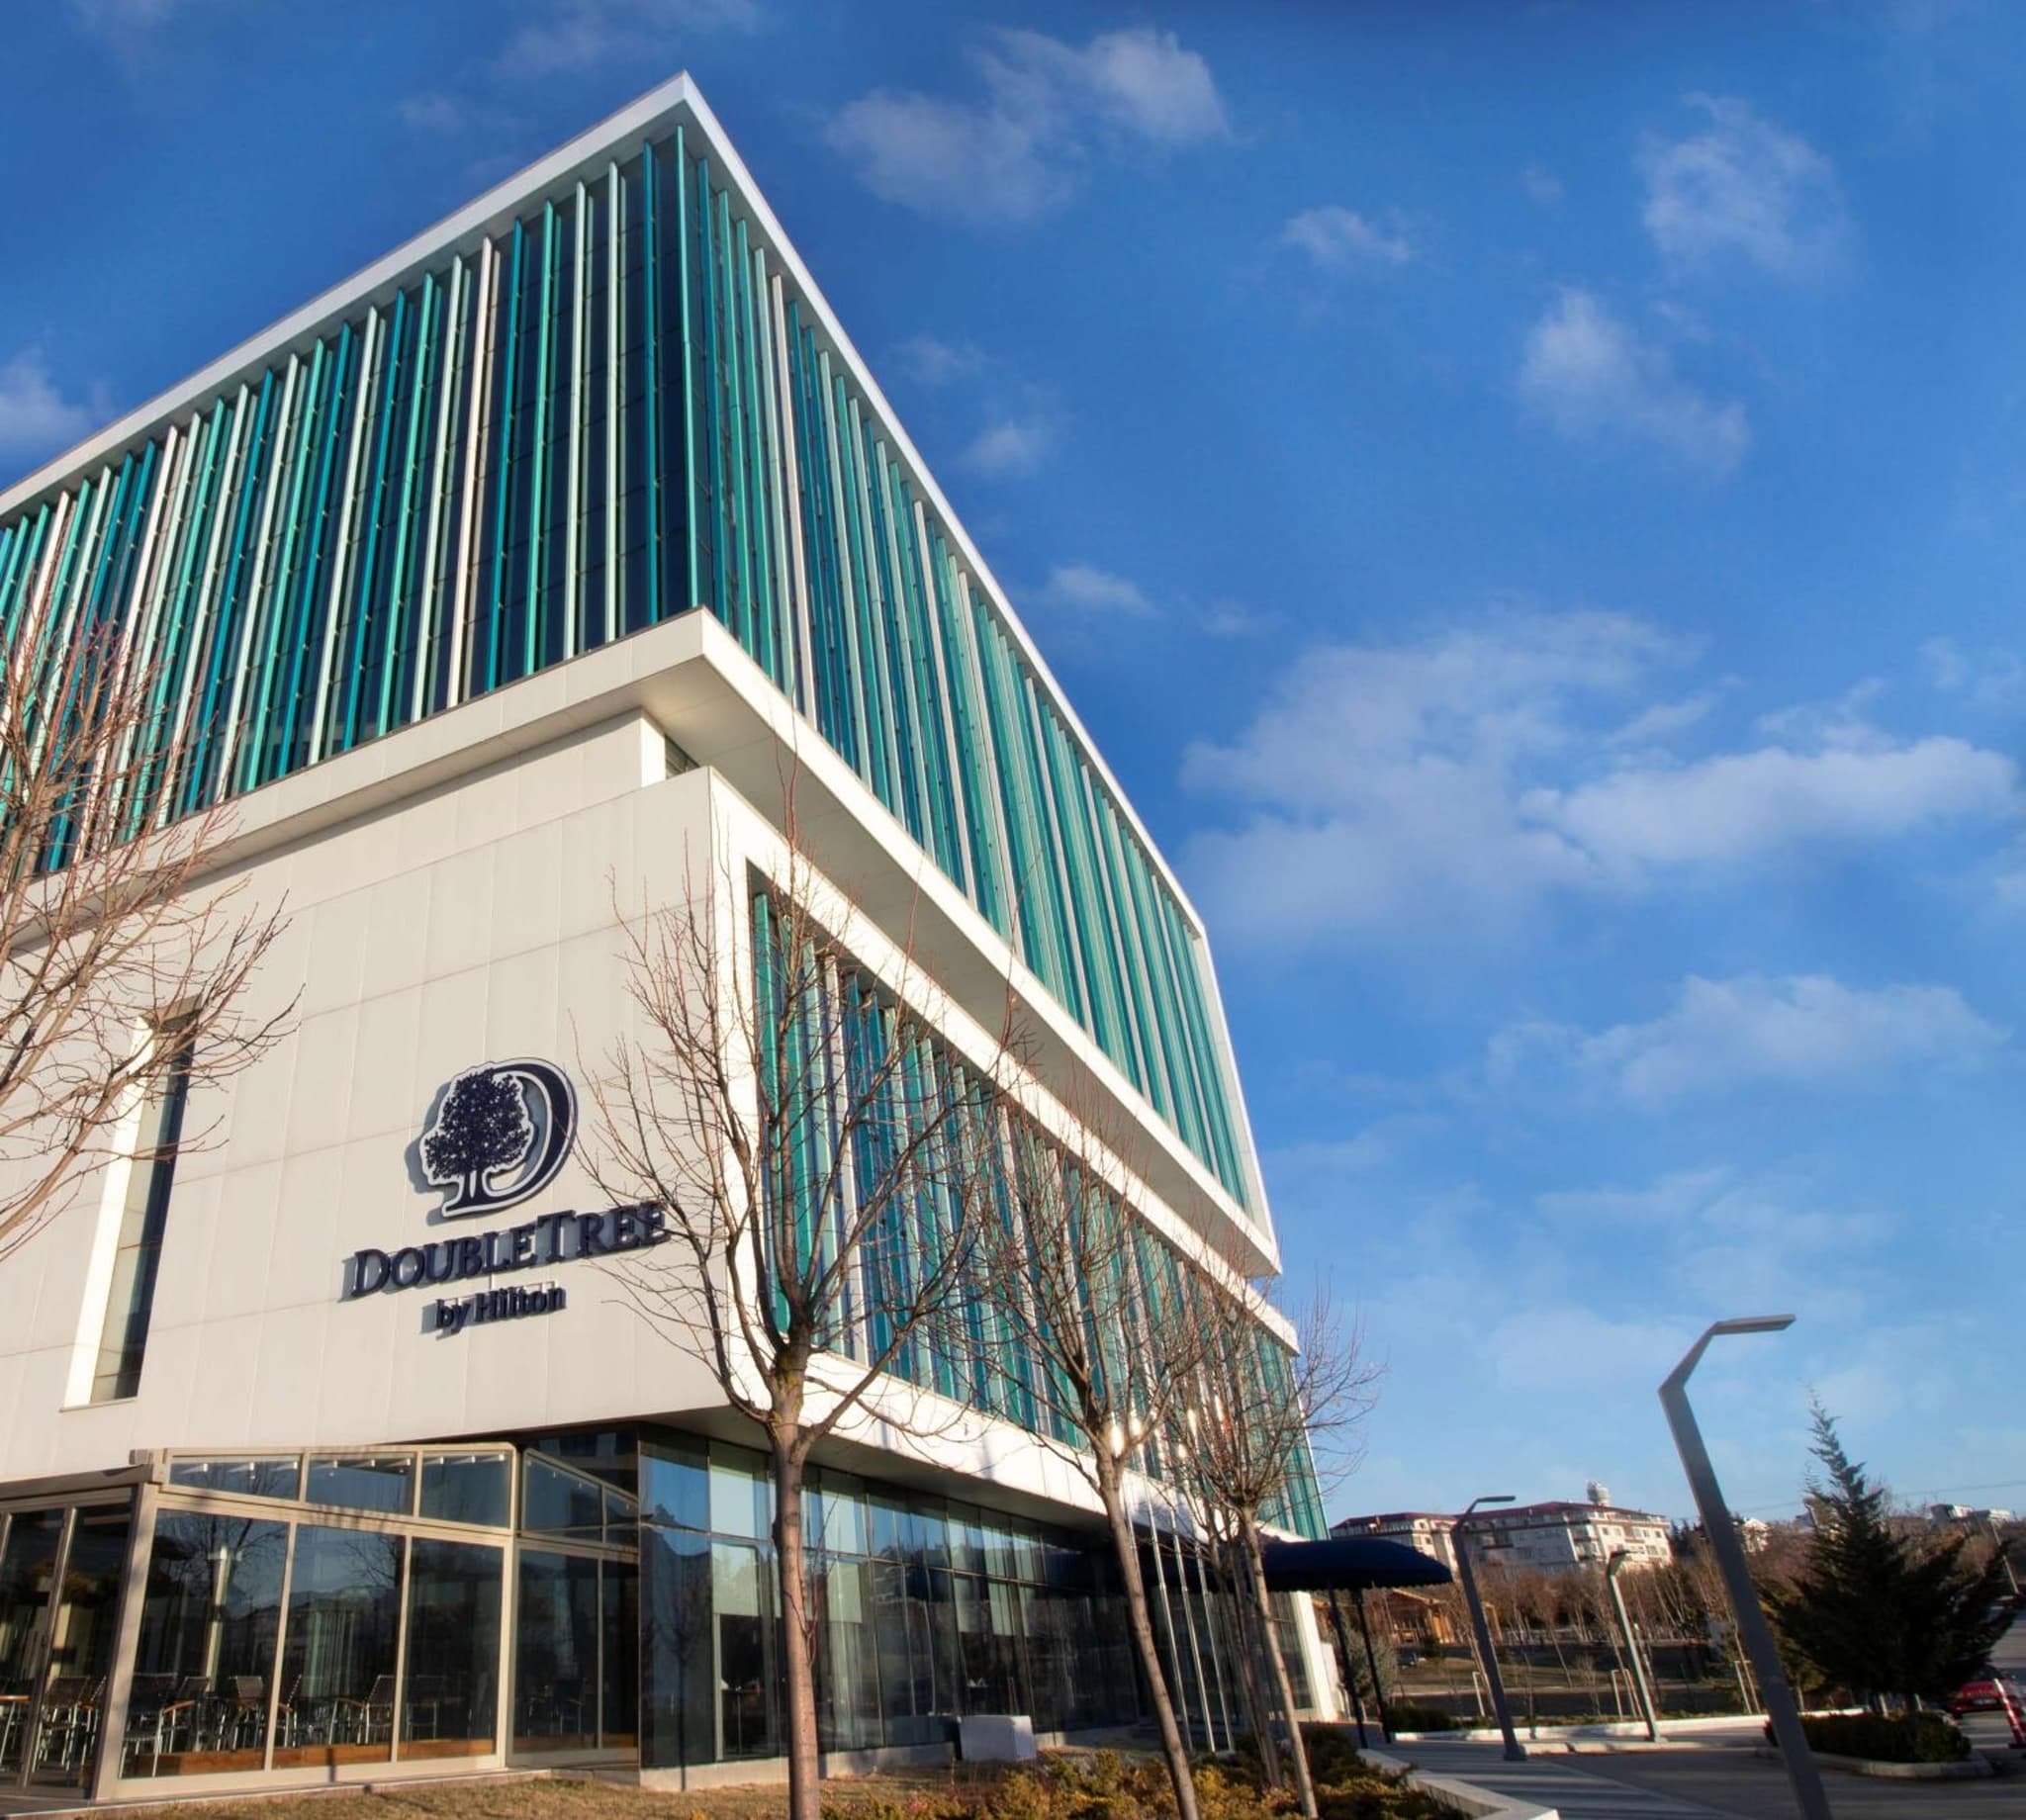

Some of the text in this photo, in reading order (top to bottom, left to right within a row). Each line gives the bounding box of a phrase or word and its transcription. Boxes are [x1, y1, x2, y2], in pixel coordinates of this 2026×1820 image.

[350, 1200, 670, 1297] DOUBLETREE
[435, 1286, 566, 1333] by Hilton
